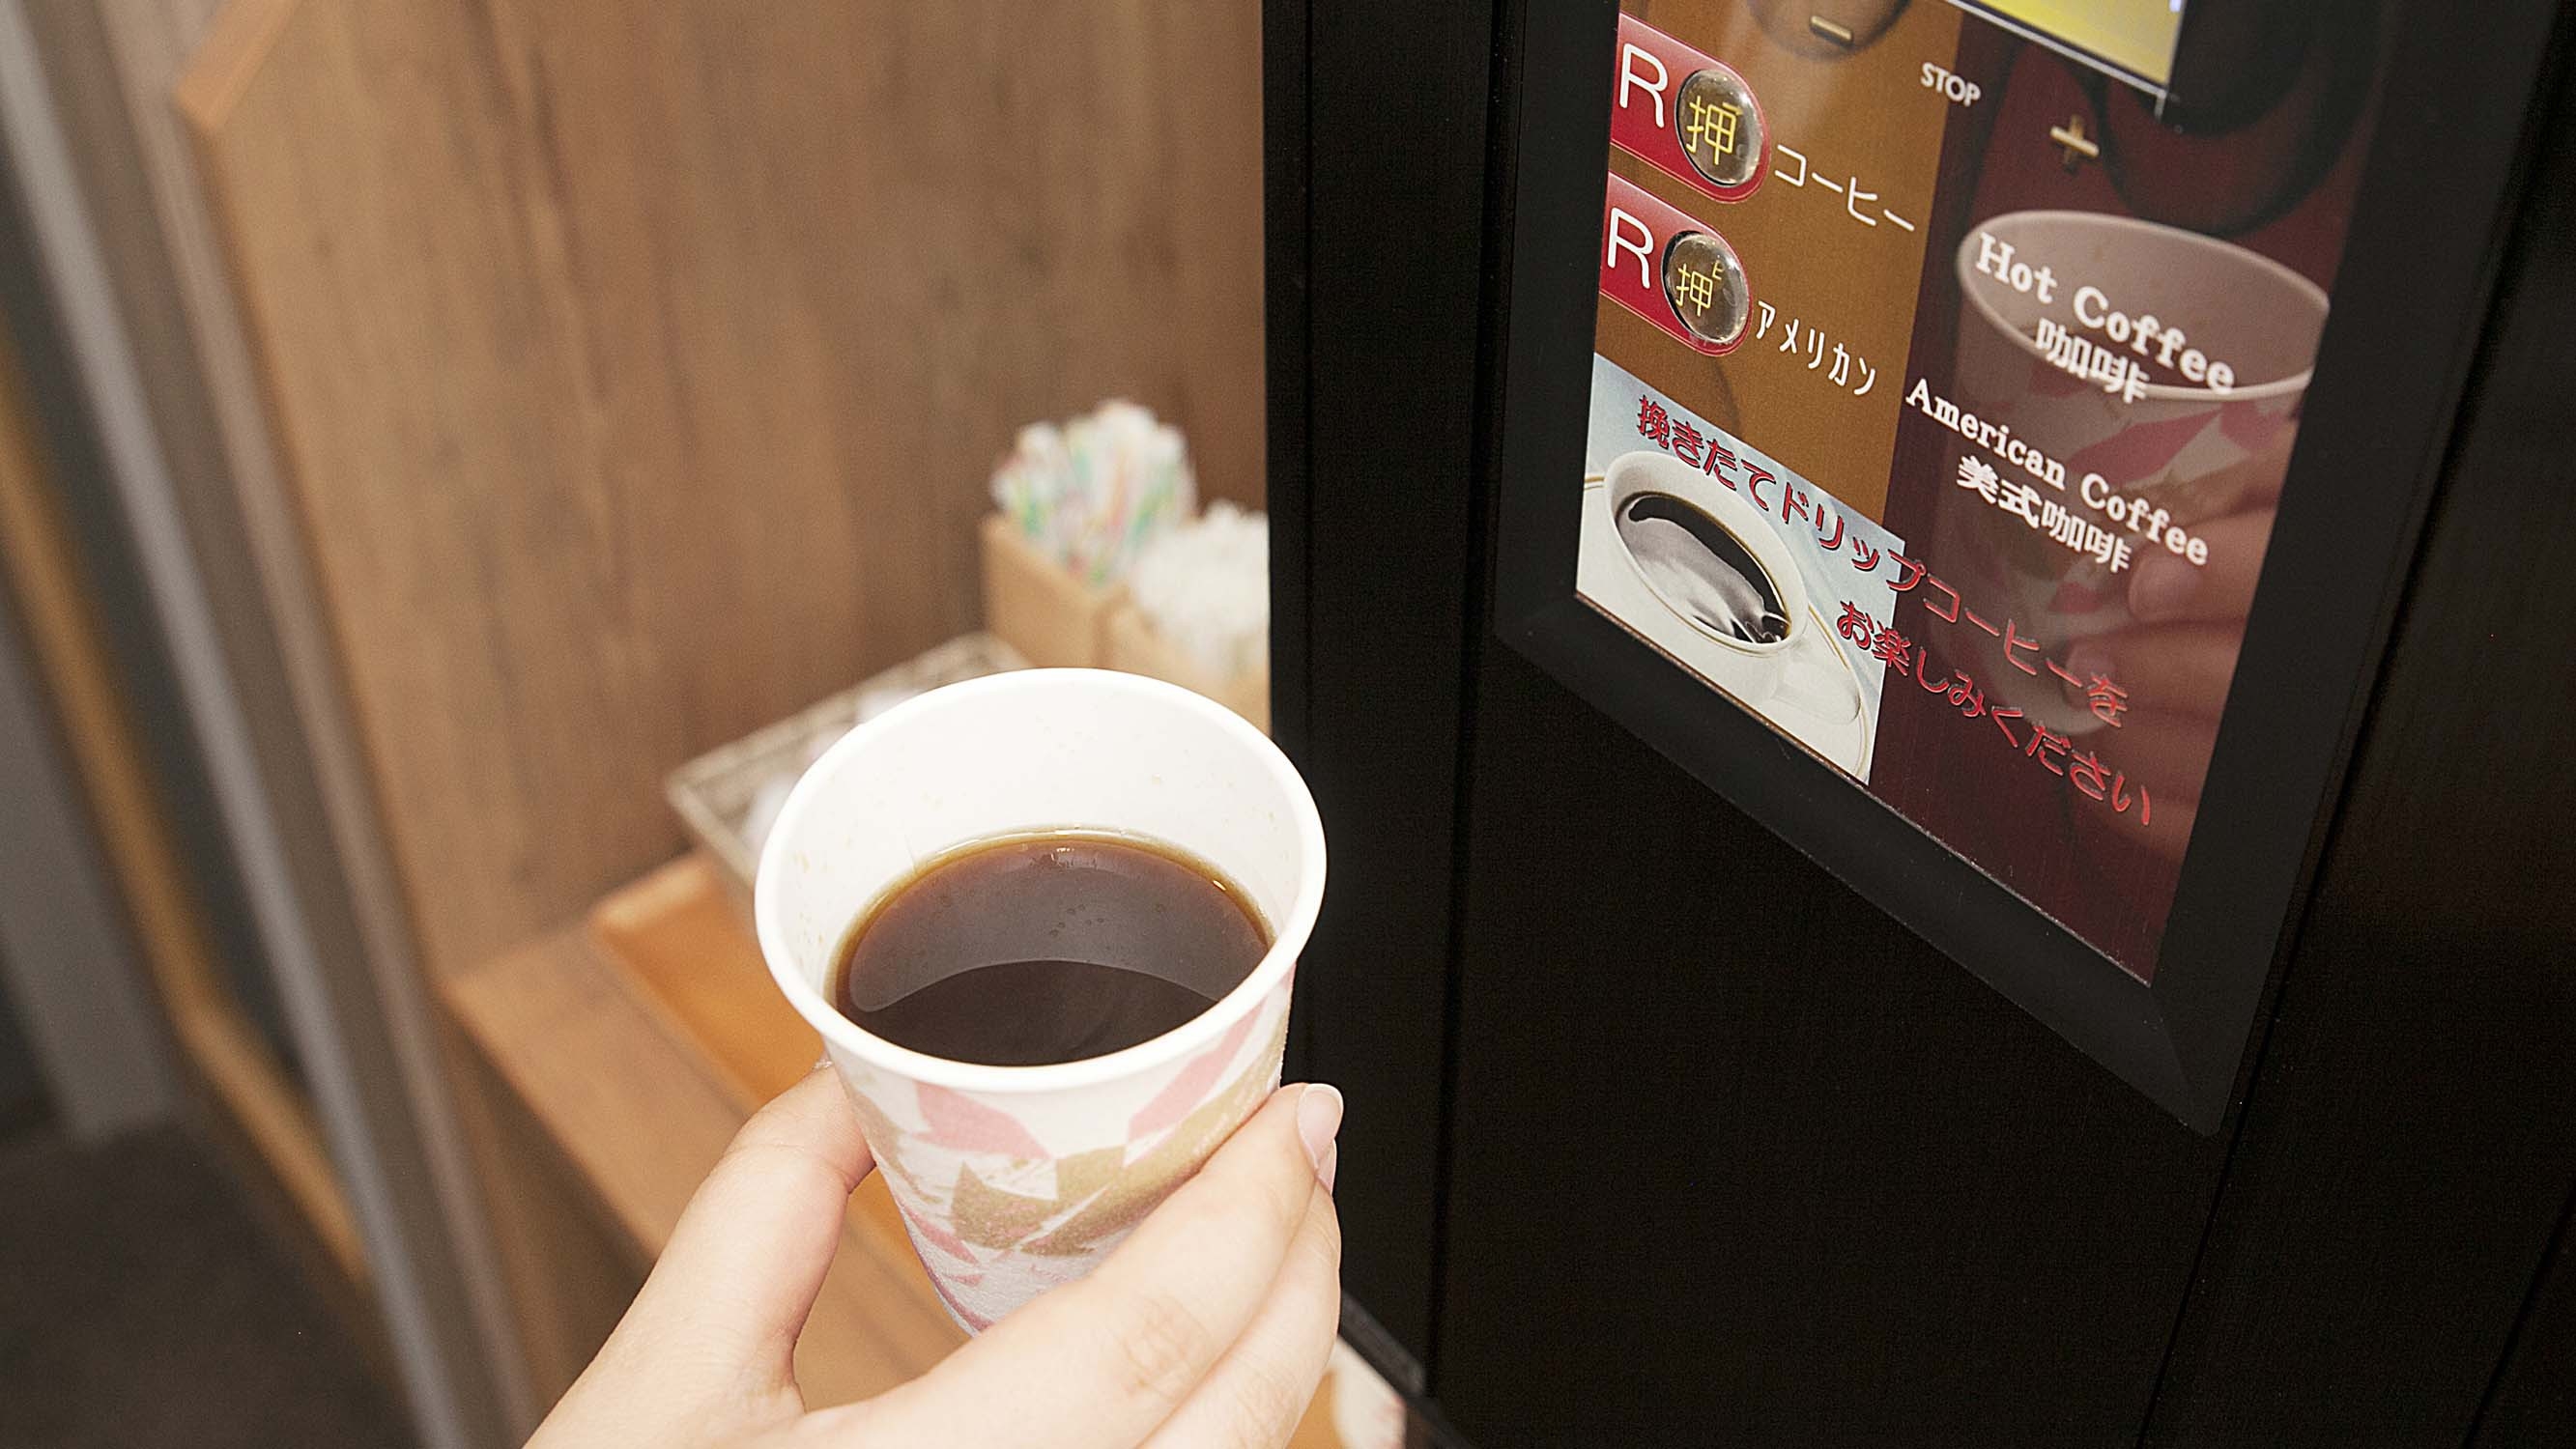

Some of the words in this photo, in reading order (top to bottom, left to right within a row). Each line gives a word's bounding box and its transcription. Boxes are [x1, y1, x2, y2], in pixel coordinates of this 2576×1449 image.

[1618, 42, 1670, 128] R
[1920, 62, 1982, 106] STOP
[1775, 144, 1915, 232] コーヒー
[1606, 207, 1655, 290] R
[1754, 299, 1876, 396] アメリカン
[1976, 232, 2057, 304] Hot
[2073, 287, 2236, 394] Coffee
[2035, 318, 2150, 404] 咖啡
[1905, 378, 2066, 491] American
[2080, 473, 2209, 566] Coffee
[1957, 455, 2132, 573] 美式咖啡
[1637, 394, 2128, 728] 挽きたてドリップコーヒーを
[1836, 599, 2150, 826] お楽しみください
